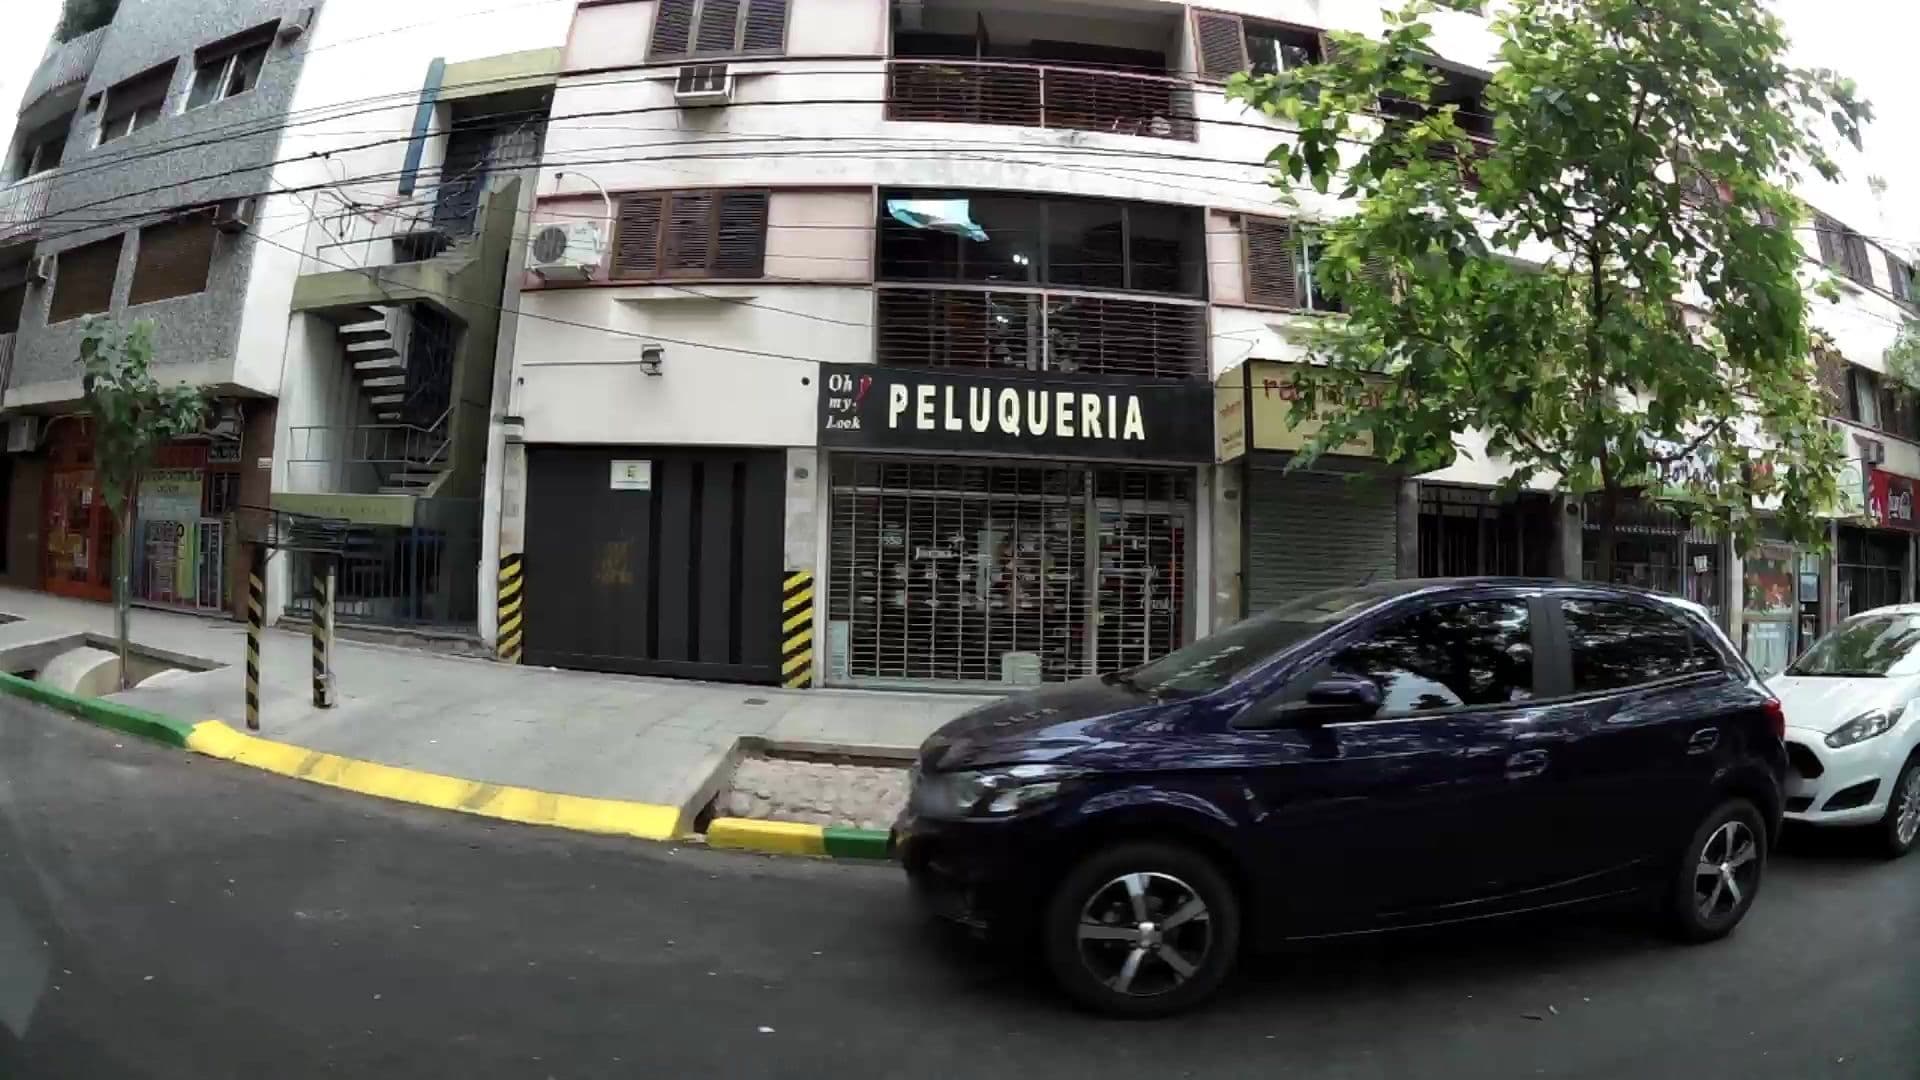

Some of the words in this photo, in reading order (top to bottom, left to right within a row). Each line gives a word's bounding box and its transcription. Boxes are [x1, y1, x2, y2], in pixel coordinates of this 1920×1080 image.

[829, 374, 852, 392] Oh
[828, 398, 852, 413] my
[888, 383, 1146, 441] PELUQUERIA
[825, 415, 861, 429] Look
